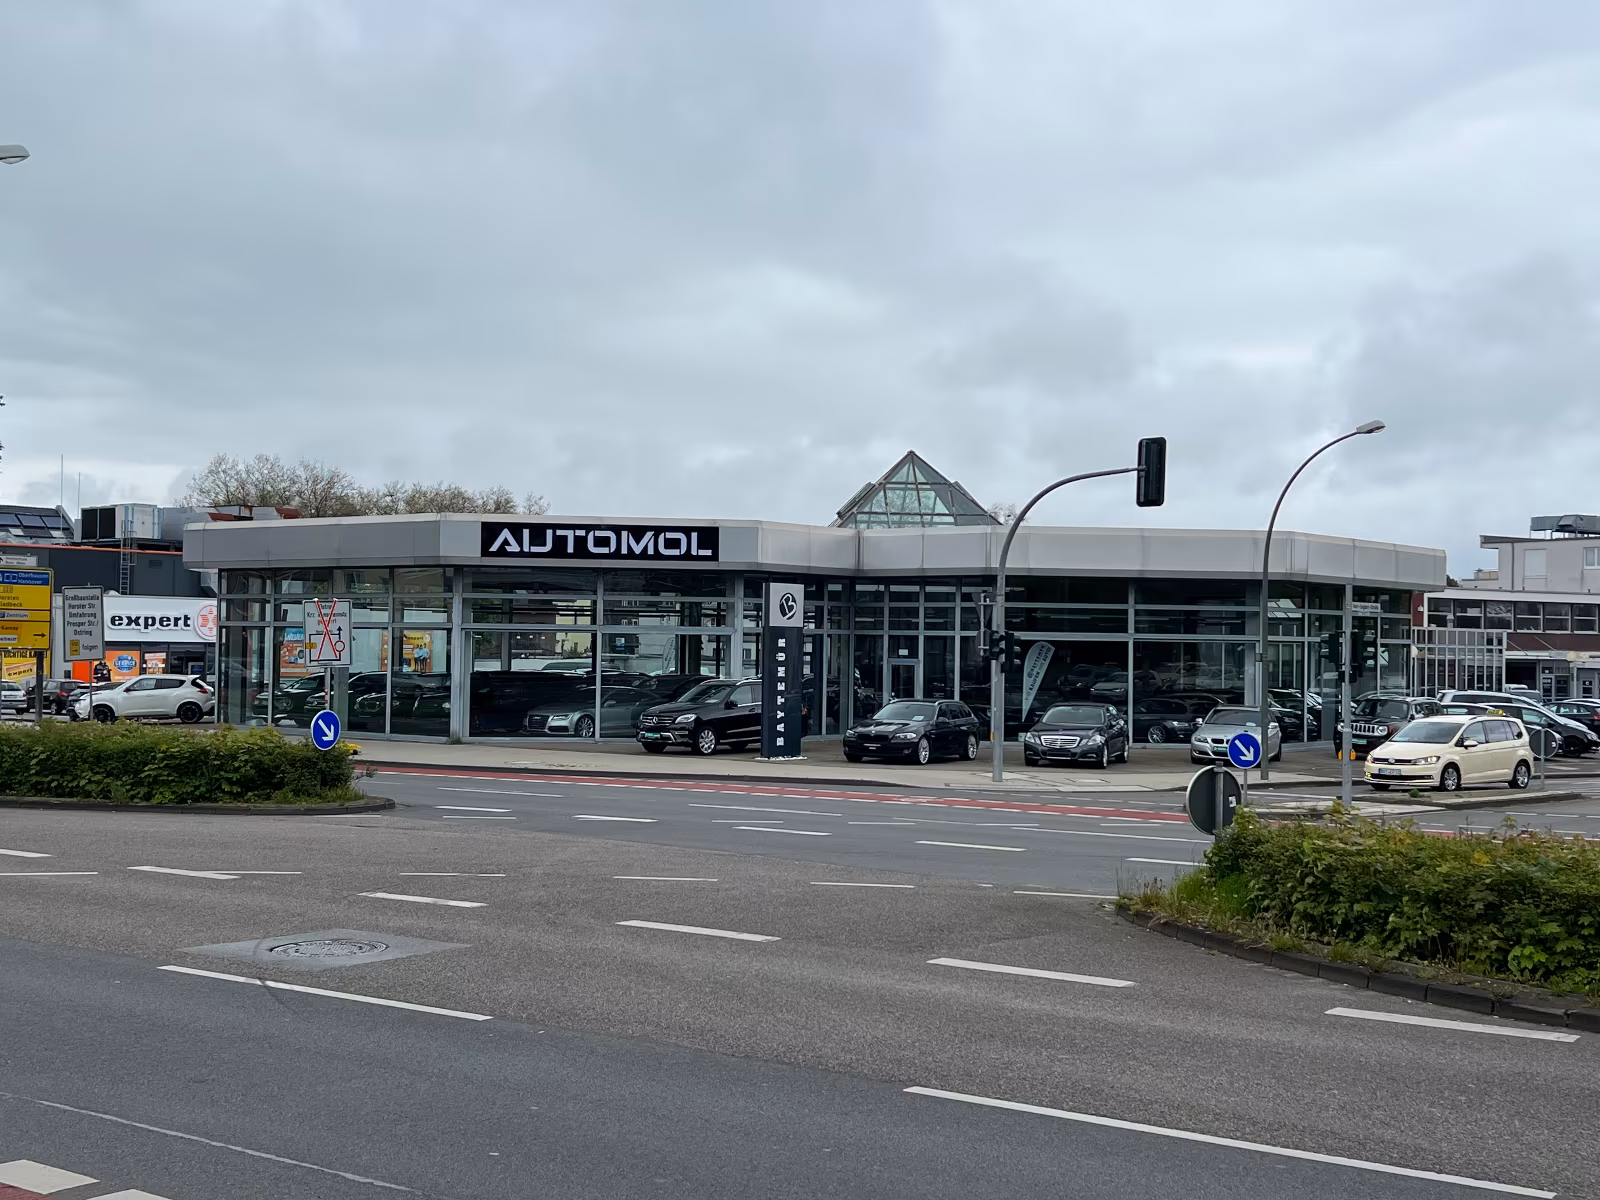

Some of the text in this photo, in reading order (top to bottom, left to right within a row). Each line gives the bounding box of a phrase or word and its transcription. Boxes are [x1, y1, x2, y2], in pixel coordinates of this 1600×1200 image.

[489, 527, 712, 556] AUTOMOL
[69, 611, 97, 619] Umfahrung
[67, 620, 86, 628] Prosper
[110, 614, 191, 630] expert
[73, 629, 93, 637] Ostring
[82, 643, 99, 651] folgen
[776, 638, 786, 746] BAYTEMÜR
